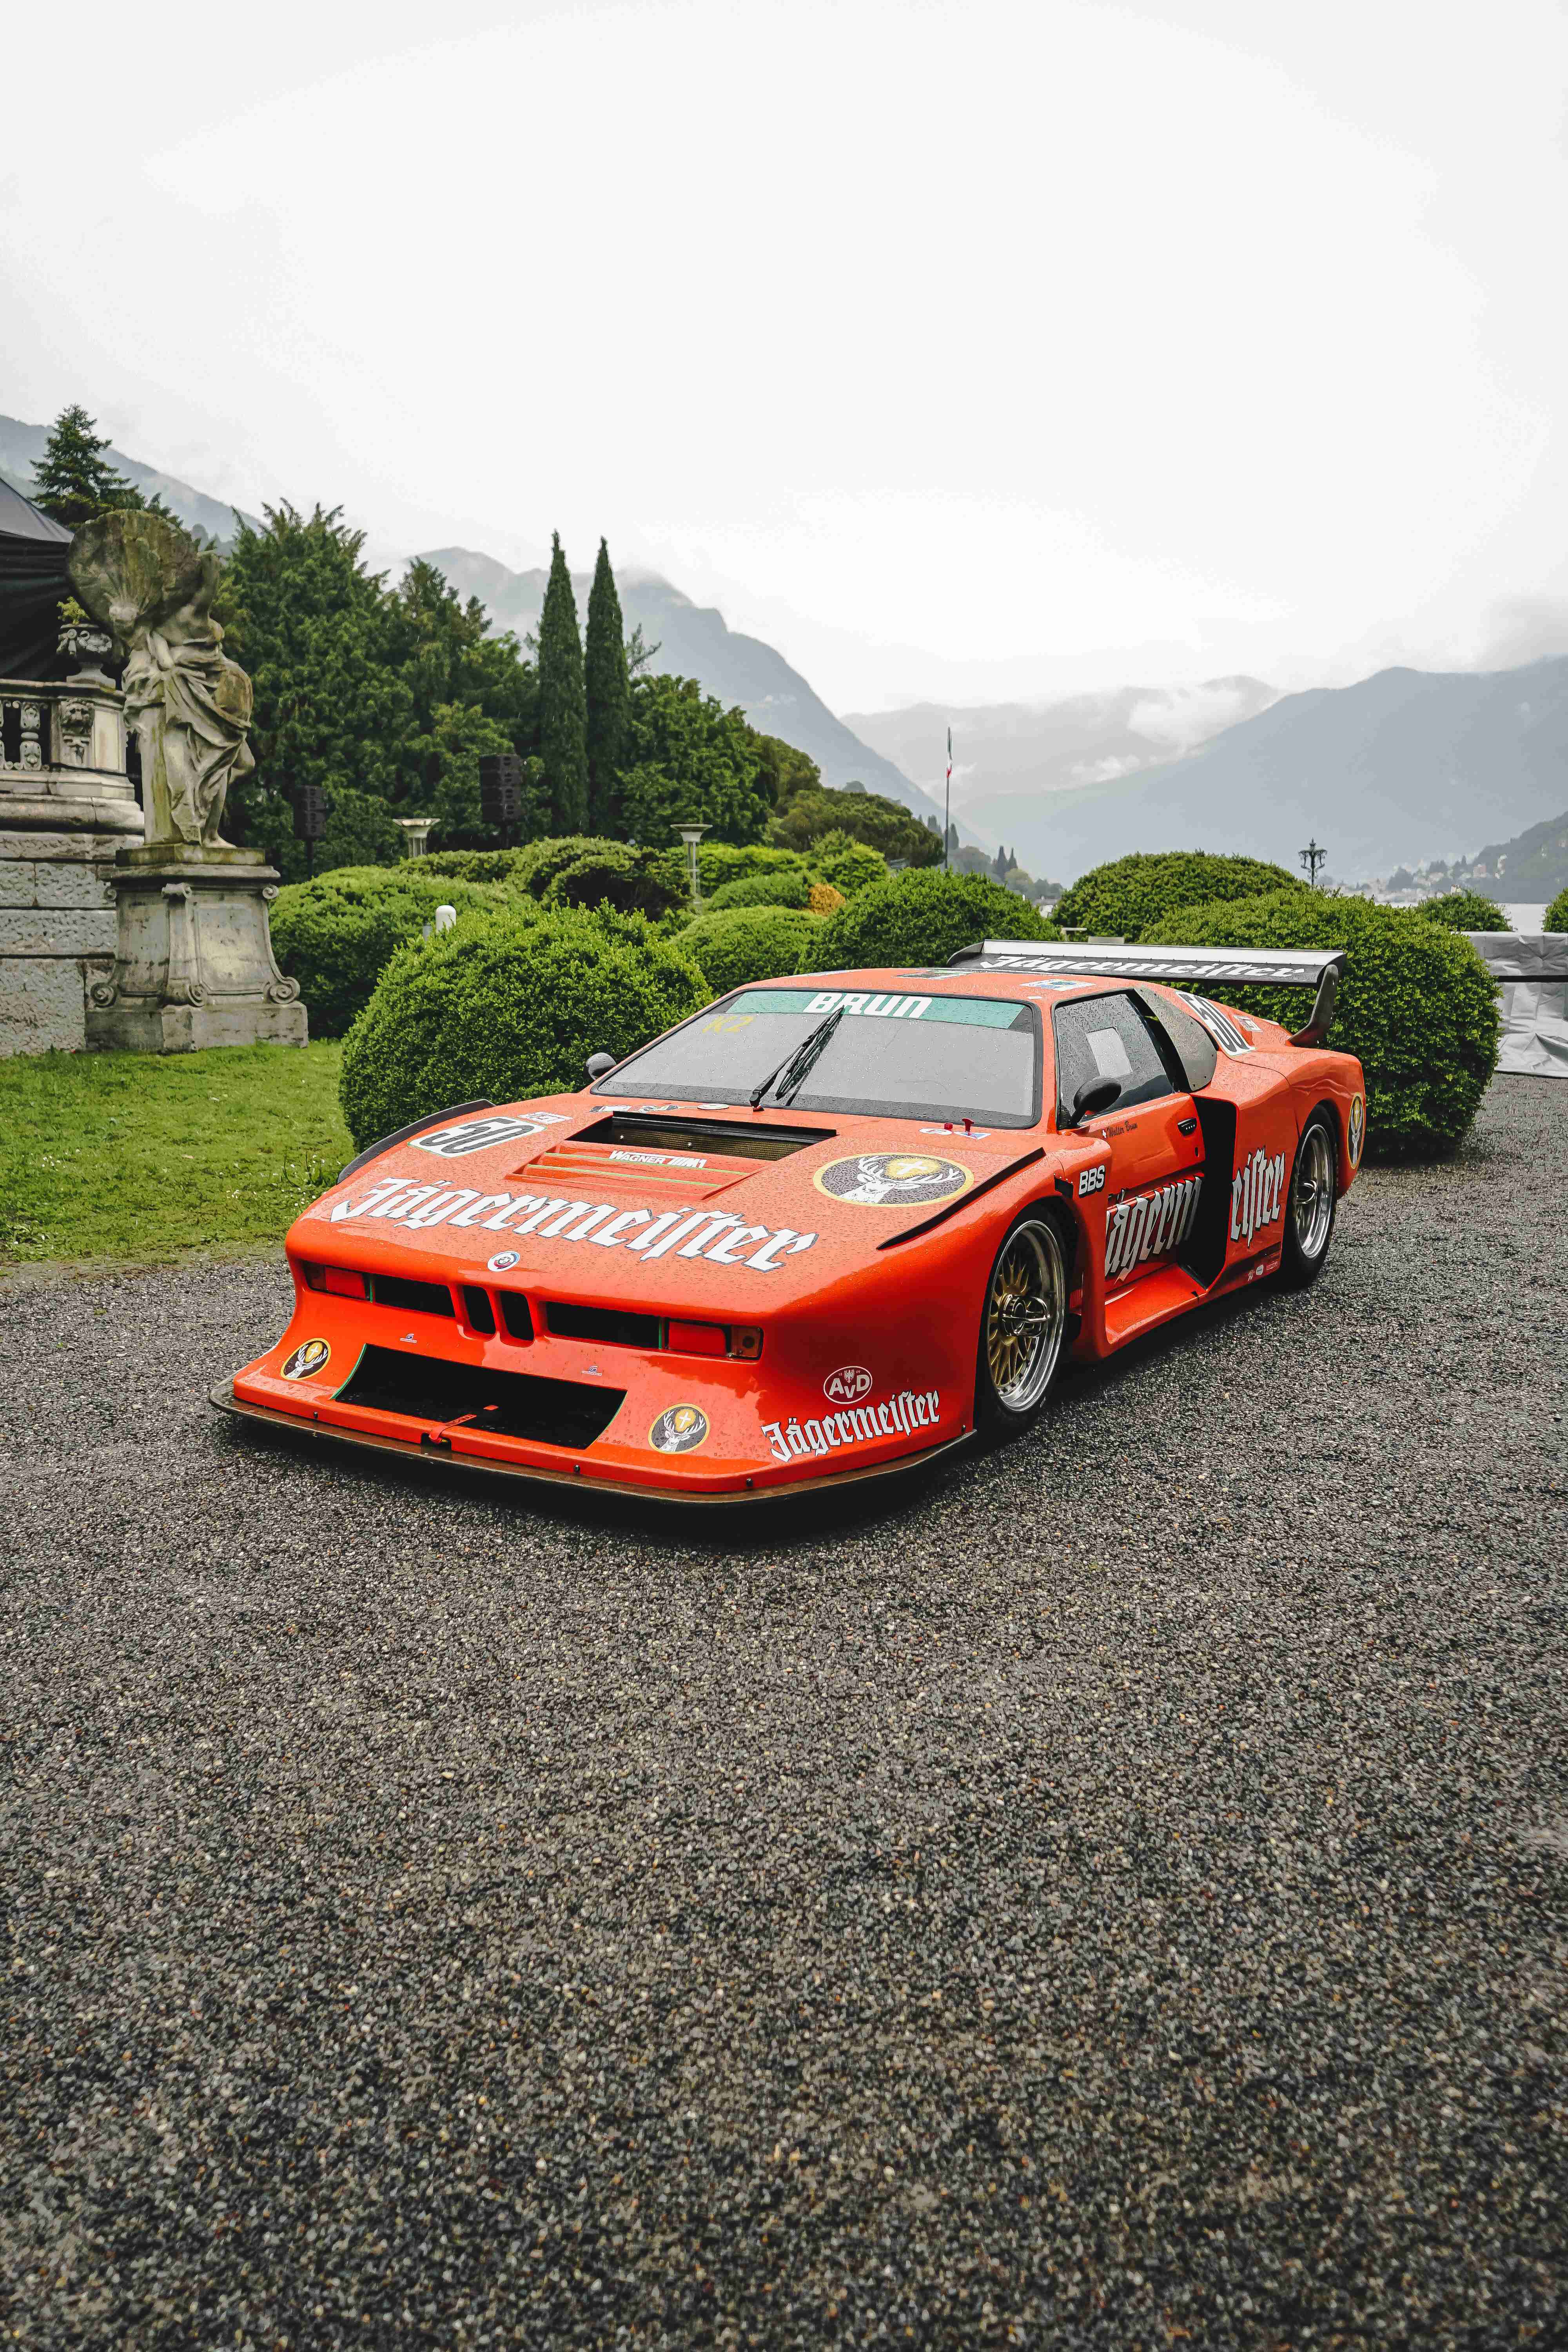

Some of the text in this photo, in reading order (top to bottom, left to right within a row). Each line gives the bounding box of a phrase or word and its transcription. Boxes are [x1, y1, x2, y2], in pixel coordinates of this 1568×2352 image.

[803, 993, 933, 1018] BRUN
[420, 1118, 535, 1153] 50
[609, 1151, 666, 1164] WAGNER
[1078, 1165, 1105, 1196] BBS
